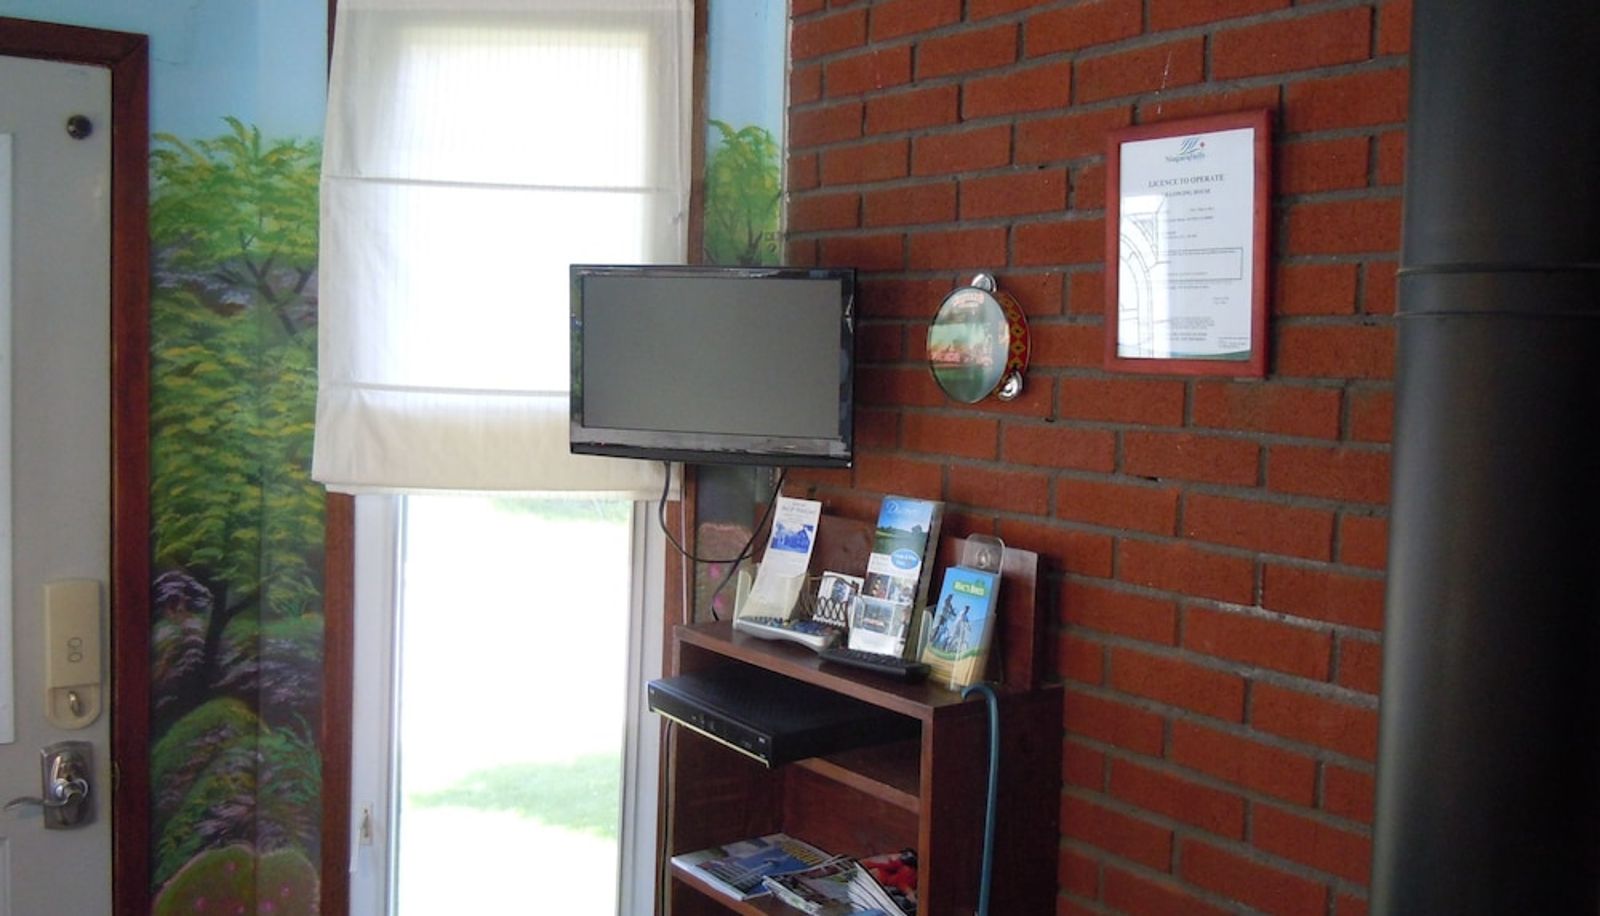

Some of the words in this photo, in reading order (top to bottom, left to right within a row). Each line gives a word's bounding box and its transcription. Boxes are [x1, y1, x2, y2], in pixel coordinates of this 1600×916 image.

[1148, 178, 1179, 188] LICENCE
[1180, 177, 1189, 185] TO
[1190, 174, 1224, 184] OPERATE
